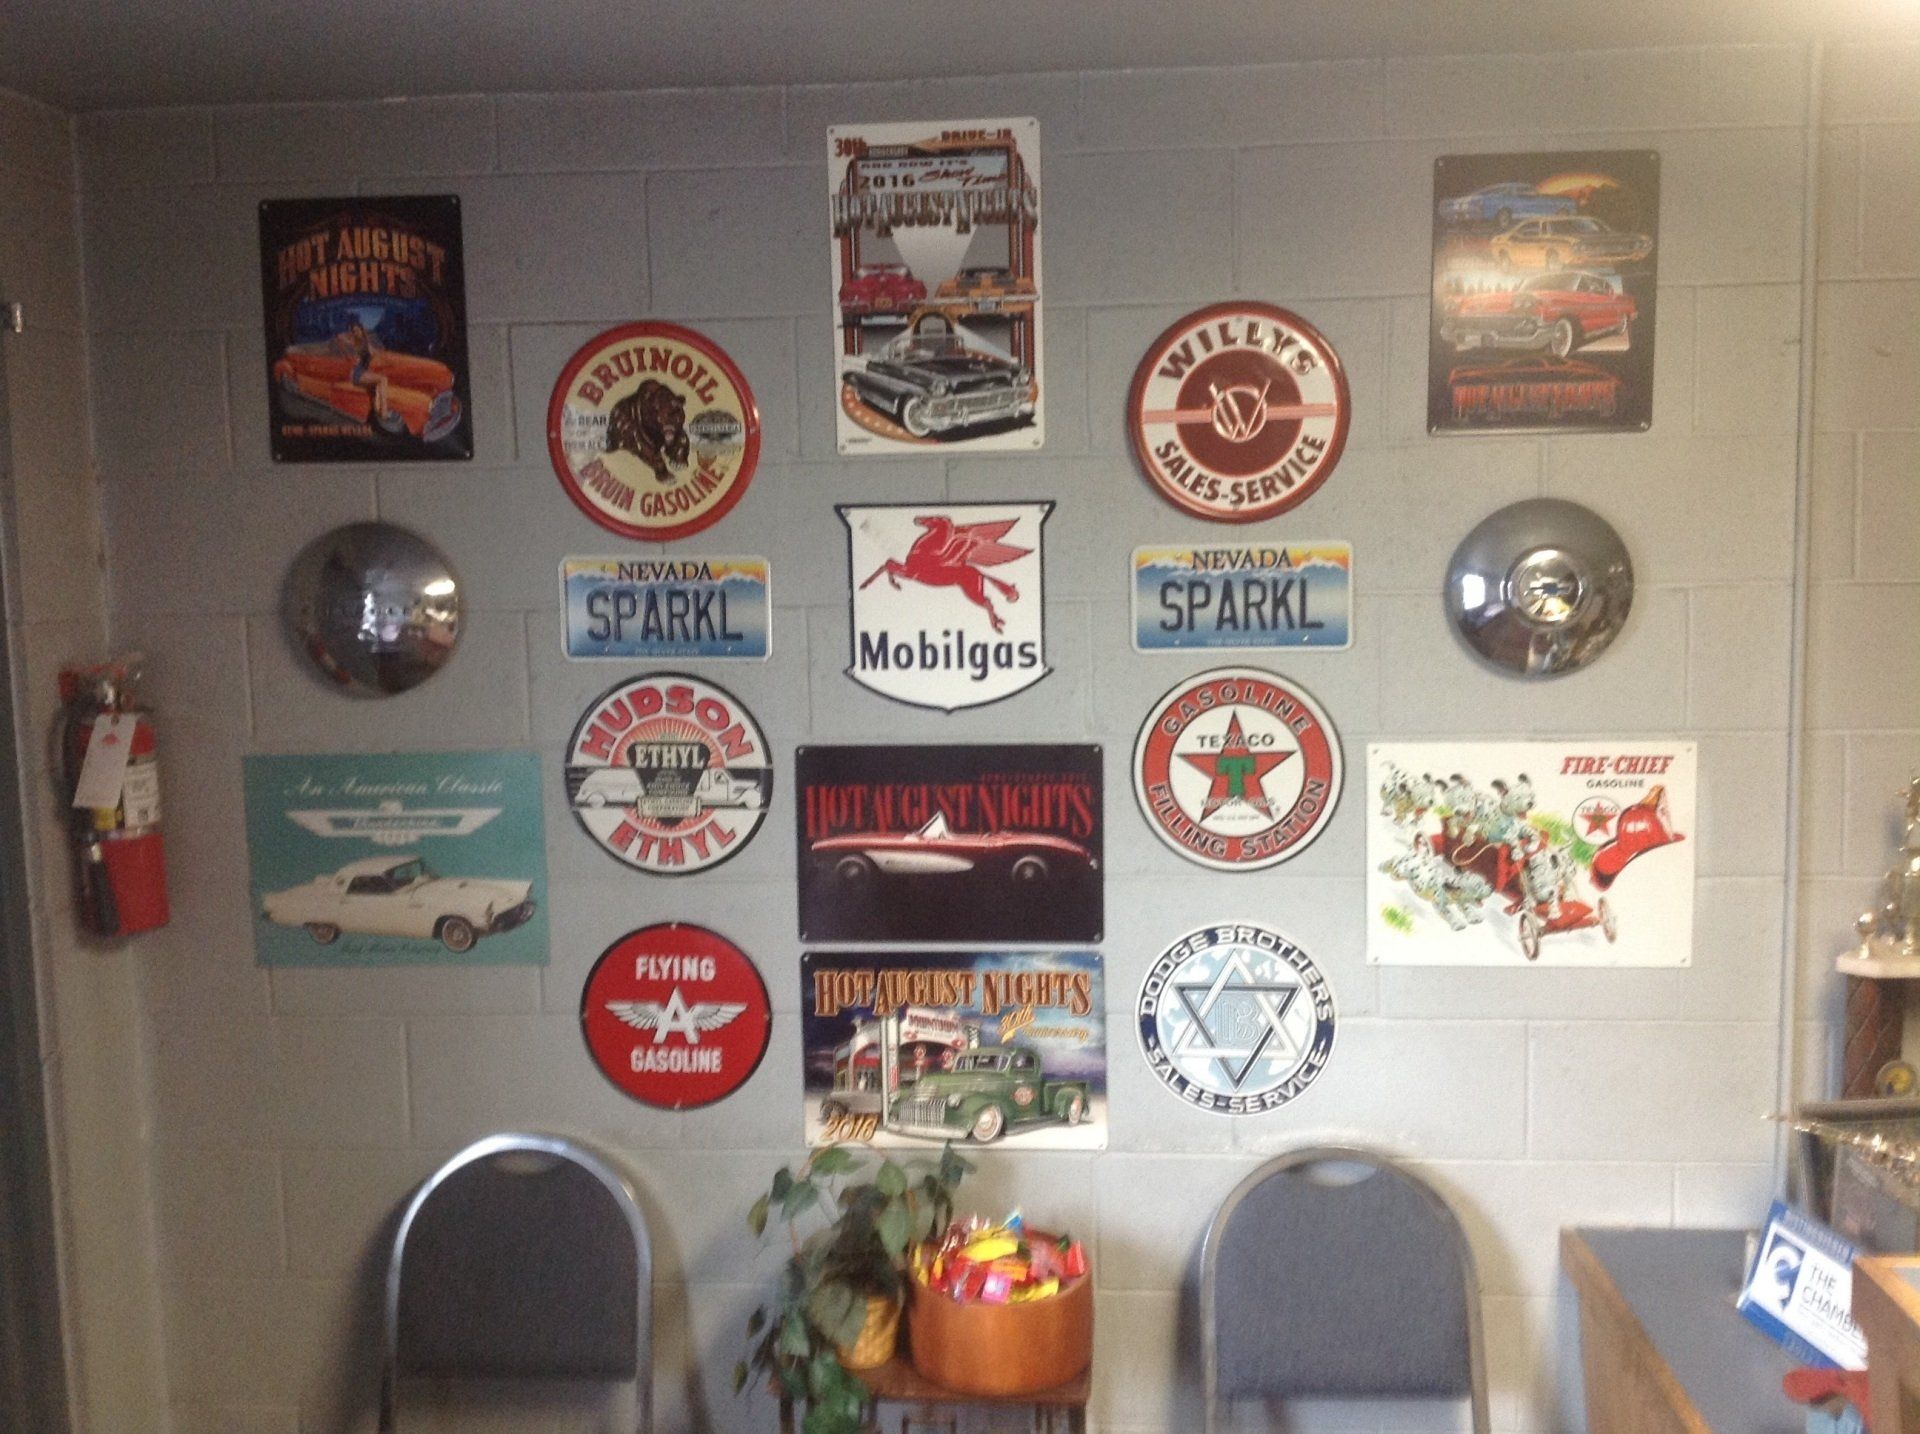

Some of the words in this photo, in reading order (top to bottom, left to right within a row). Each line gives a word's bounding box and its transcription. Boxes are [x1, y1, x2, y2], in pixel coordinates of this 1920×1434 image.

[858, 172, 916, 189] 2016
[276, 231, 330, 290] HOT
[336, 226, 447, 286] AUGUST
[308, 261, 417, 300] NIGHTS
[1158, 321, 1318, 380] WILLYS
[577, 347, 719, 407] BRUINOIL
[579, 459, 635, 512] BRUIN
[639, 464, 726, 517] GASOLINE
[1155, 434, 1326, 505] SALES-SERVICE
[617, 560, 713, 582] NEVADA
[1190, 547, 1293, 571] NEVADA
[586, 588, 744, 642] SPARKL
[1159, 576, 1326, 633] SPARKL
[859, 629, 1038, 681] Mobilgas
[580, 685, 755, 761] HUDSON
[1161, 684, 1313, 737] GASOLINE
[634, 743, 706, 769] ETHYL
[1197, 732, 1276, 749] TEXACO
[1559, 754, 1674, 775] FIRE-CHIEF
[1586, 779, 1645, 789] GASOLINE
[805, 783, 866, 839] HOT
[979, 783, 1093, 838] NIGHTS
[1151, 782, 1228, 857] FILLING
[1240, 778, 1325, 857] STATION
[609, 820, 737, 865] ETHYL
[635, 955, 716, 981] FLYING
[813, 969, 874, 1017] HOT
[871, 969, 976, 1017] AUGUST
[981, 969, 1093, 1017] NIGHTS
[1140, 929, 1209, 1016] DODGE
[1215, 927, 1332, 1021] BROTHERS
[630, 1046, 723, 1074] GASOLINE
[1810, 1263, 1838, 1291] THE
